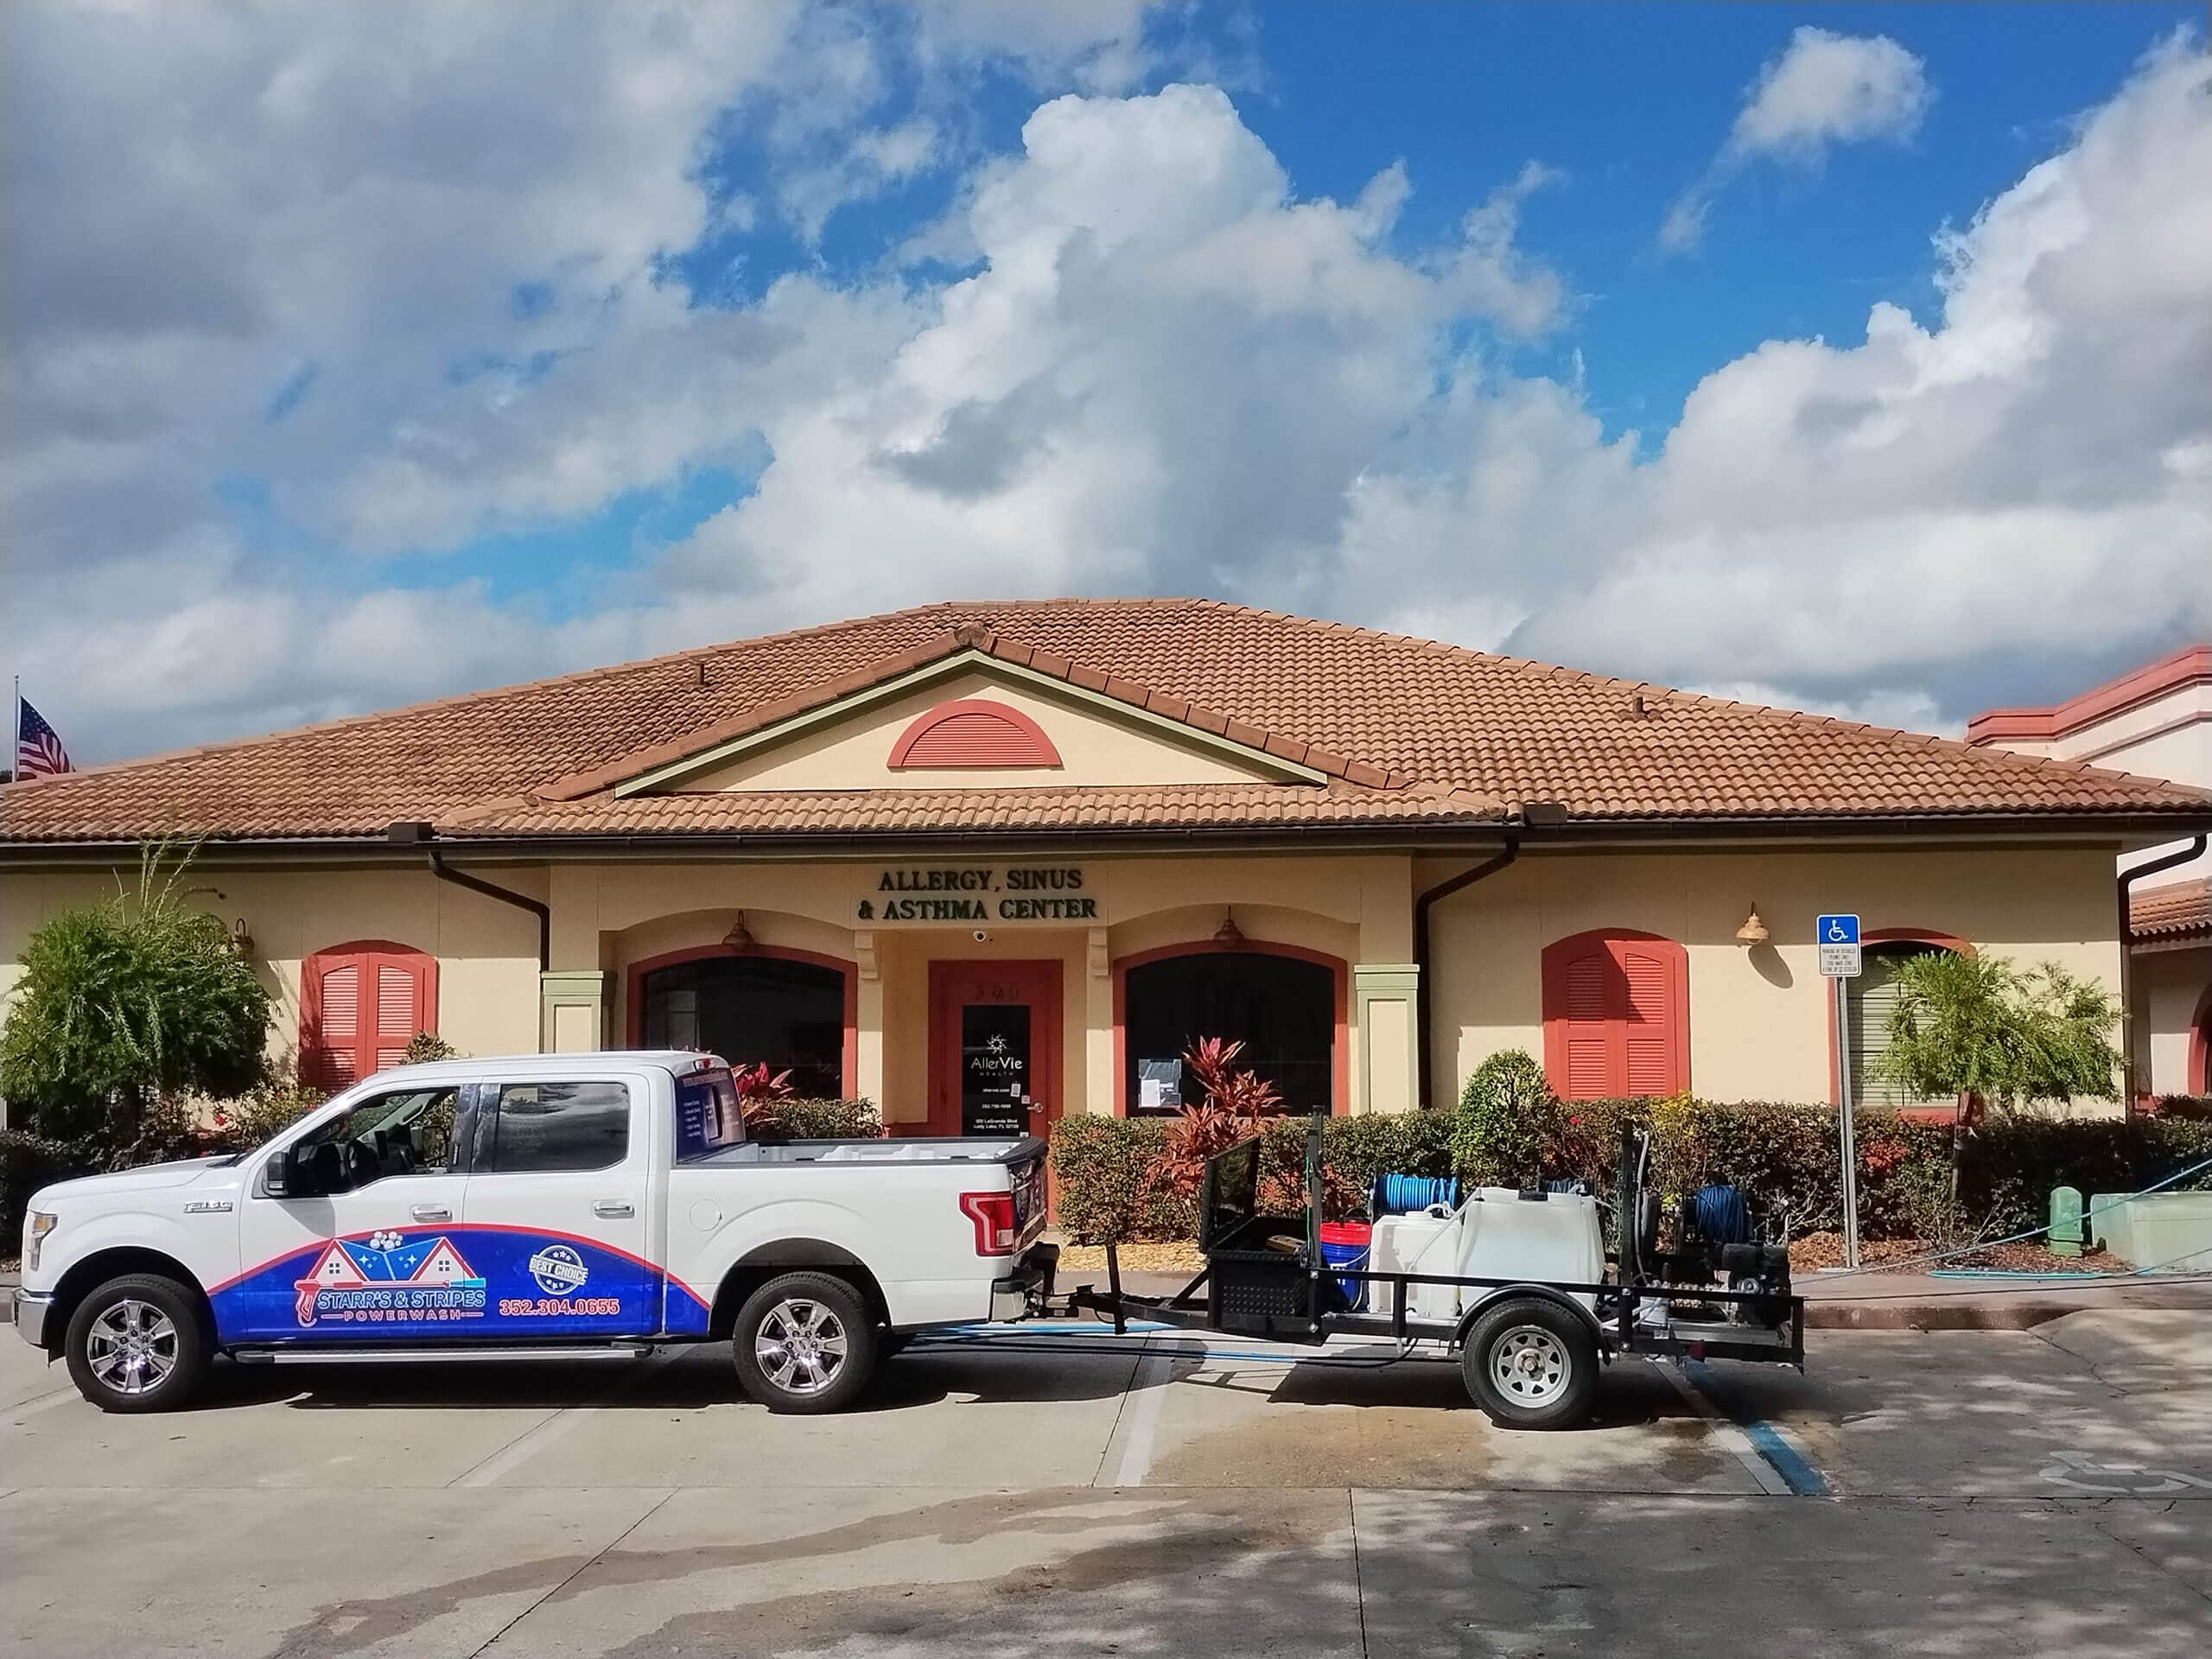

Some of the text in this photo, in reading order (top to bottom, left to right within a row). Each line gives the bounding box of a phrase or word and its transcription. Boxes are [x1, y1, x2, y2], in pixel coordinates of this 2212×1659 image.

[878, 869, 1083, 892] ALLERGY, SINUS
[857, 898, 1097, 920] & ASTHMA CENTER
[529, 1257, 588, 1281] BEST CHOICE
[317, 1291, 486, 1308] STARR'S & STRIPES
[499, 1299, 620, 1316] 352.304.0655
[344, 1310, 461, 1322] POWERWASH
